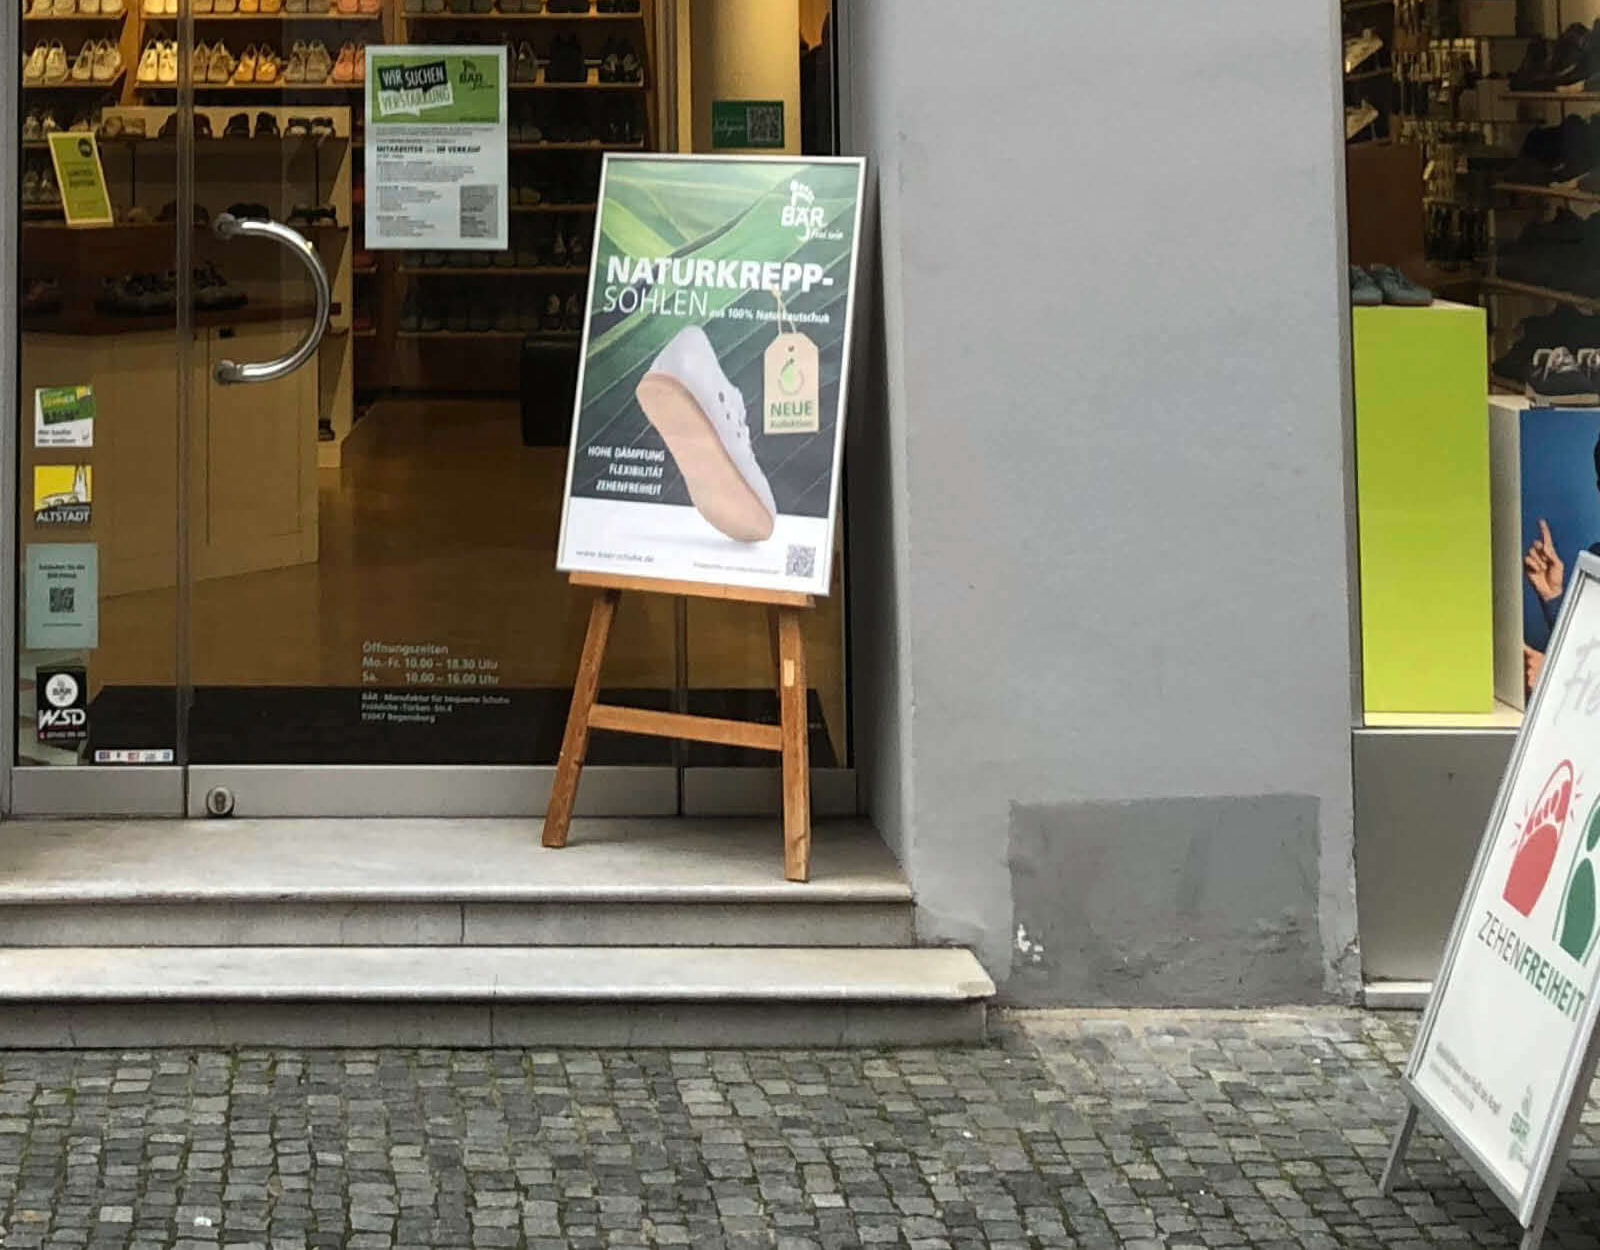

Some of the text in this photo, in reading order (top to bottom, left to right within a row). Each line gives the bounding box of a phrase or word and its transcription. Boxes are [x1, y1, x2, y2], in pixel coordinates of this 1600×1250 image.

[382, 66, 444, 88] WIR SUCHEN
[607, 256, 834, 293] NATURKREPP-
[603, 285, 709, 317] SOHLEN
[727, 308, 754, 320] 100%
[770, 400, 814, 417] NEUE
[587, 445, 613, 458] HOHE
[35, 510, 91, 523] ALTSTADT
[361, 640, 449, 656] Öffnungszeiten
[404, 657, 434, 669] 10.00
[447, 658, 476, 670] 18.30
[478, 658, 499, 670] Uhr
[405, 672, 434, 683] 10.00
[447, 673, 476, 685] 16.00
[478, 673, 499, 685] Uhr
[38, 708, 87, 729] WSD
[1477, 910, 1586, 1023] ZEHENFREIHEIT
